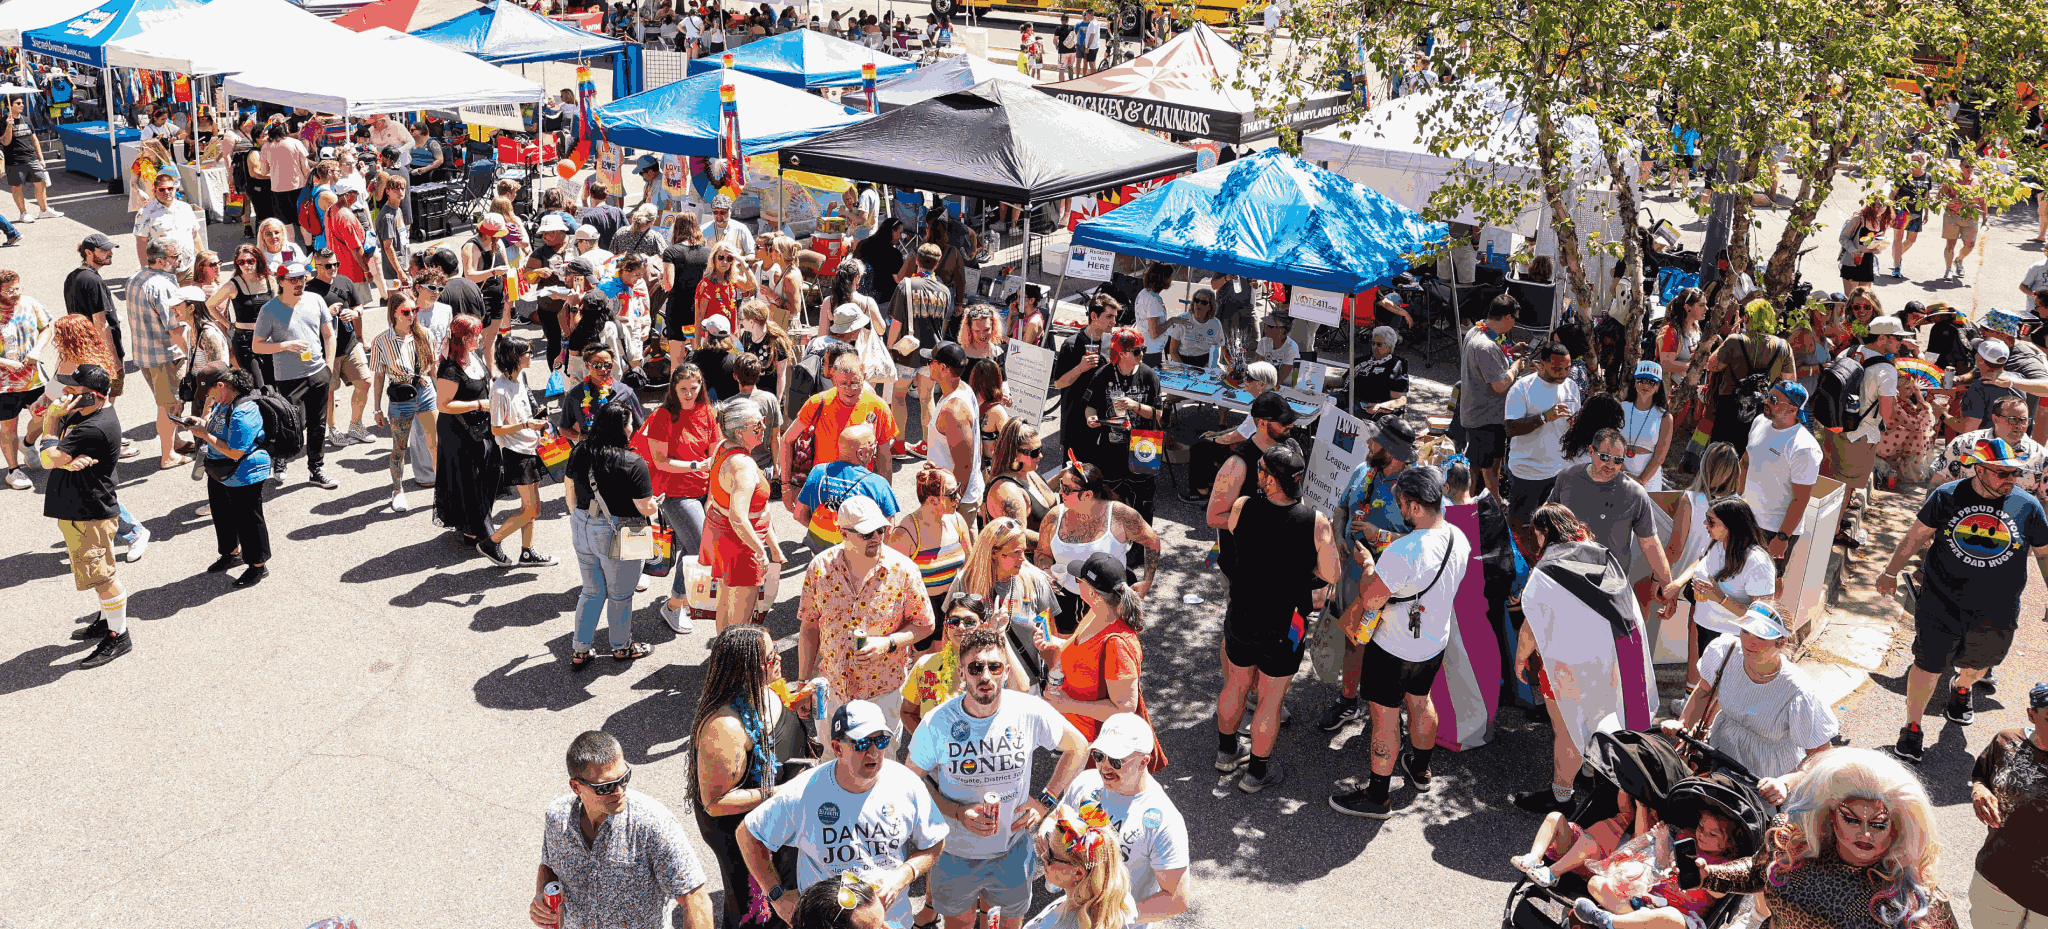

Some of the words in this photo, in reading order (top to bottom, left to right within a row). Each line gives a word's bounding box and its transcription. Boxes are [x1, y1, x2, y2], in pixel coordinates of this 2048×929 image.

[1124, 101, 1143, 123] &
[1143, 104, 1210, 135] CANNABIS
[1243, 118, 1270, 134] THAT'S
[1292, 106, 1332, 123] MARYLAND
[1087, 261, 1110, 270] HERE
[1325, 449, 1351, 473] League
[1308, 469, 1332, 494] Women
[1329, 471, 1339, 481] of
[1303, 485, 1322, 503] Anne
[1957, 505, 1994, 518] PROUD
[1995, 509, 2010, 520] OF
[2006, 519, 2020, 539] YOU
[1946, 538, 1964, 559] FREE
[1962, 556, 1986, 568] DAD
[1988, 550, 2014, 568] HUGS
[948, 736, 1012, 758] DANA
[948, 751, 1026, 775] JONES
[984, 774, 1011, 783] District
[822, 822, 887, 845] DANA
[823, 838, 900, 864] JONES
